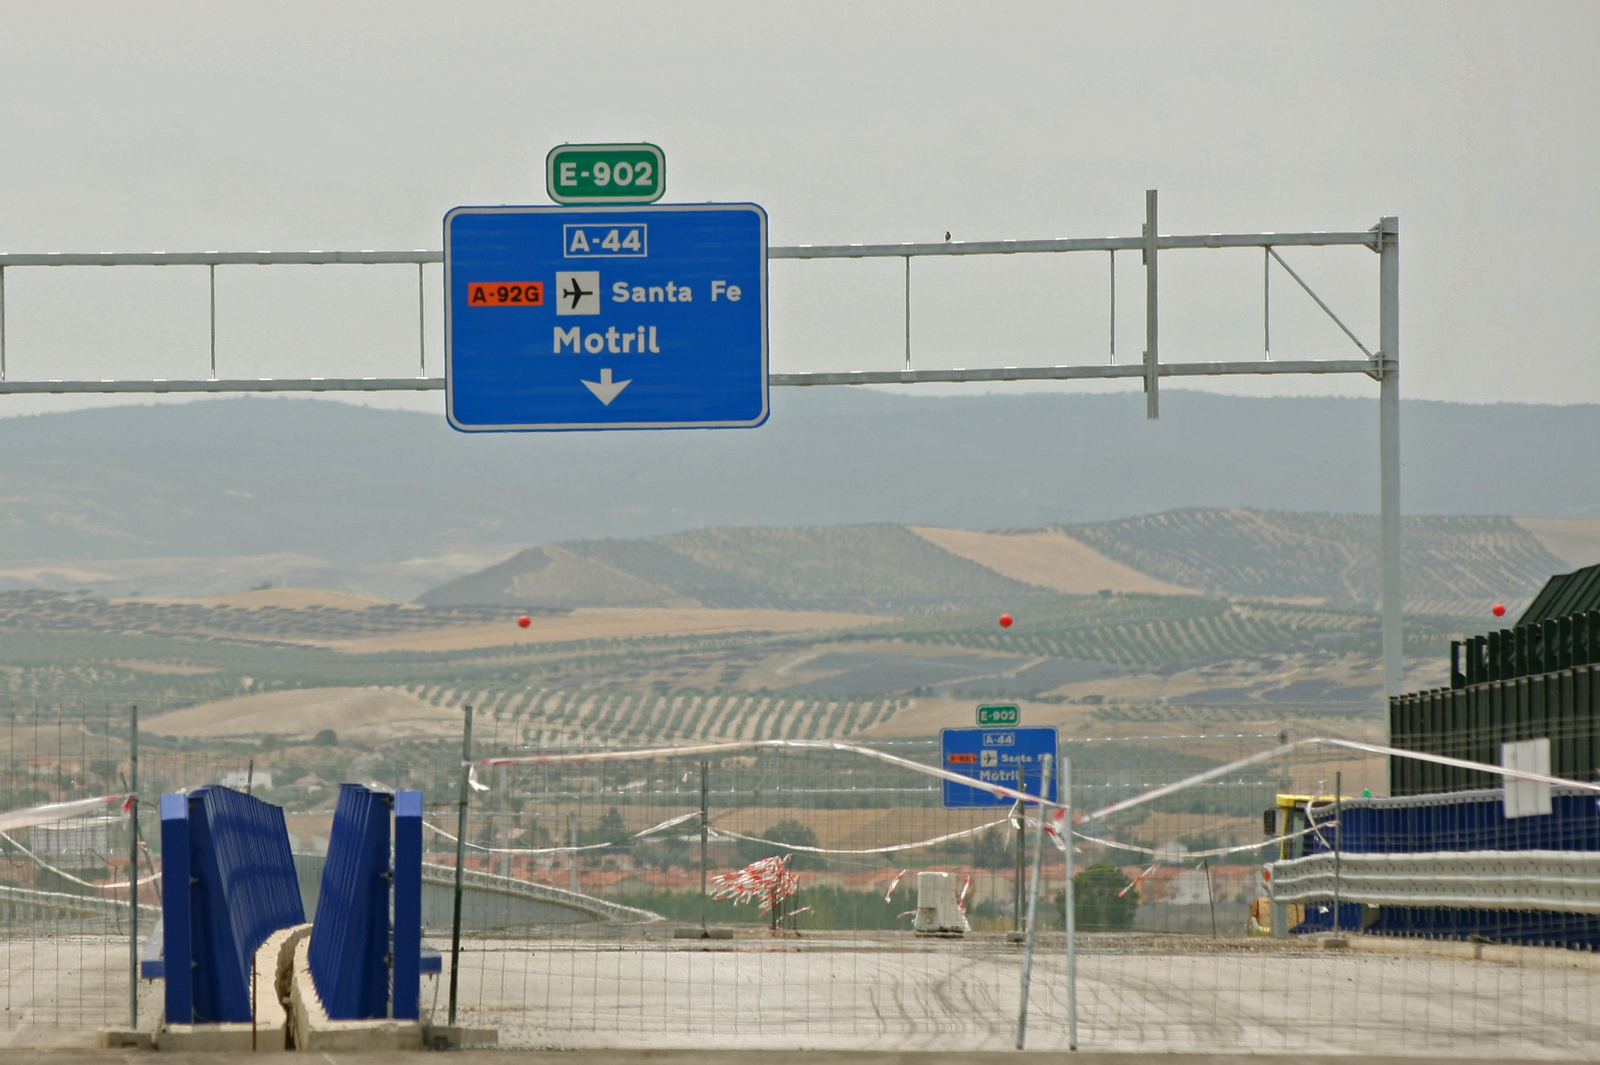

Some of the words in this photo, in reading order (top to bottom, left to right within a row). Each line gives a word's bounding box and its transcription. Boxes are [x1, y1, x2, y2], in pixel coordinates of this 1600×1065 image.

[560, 162, 653, 186] E-902
[570, 229, 641, 252] A-44
[472, 285, 539, 303] A-92G
[611, 281, 692, 303] Santa
[711, 280, 742, 302] Fe
[553, 326, 660, 354] Motril
[980, 711, 1016, 721] E-902
[985, 735, 1013, 744] A-44
[1001, 754, 1032, 763] Santa
